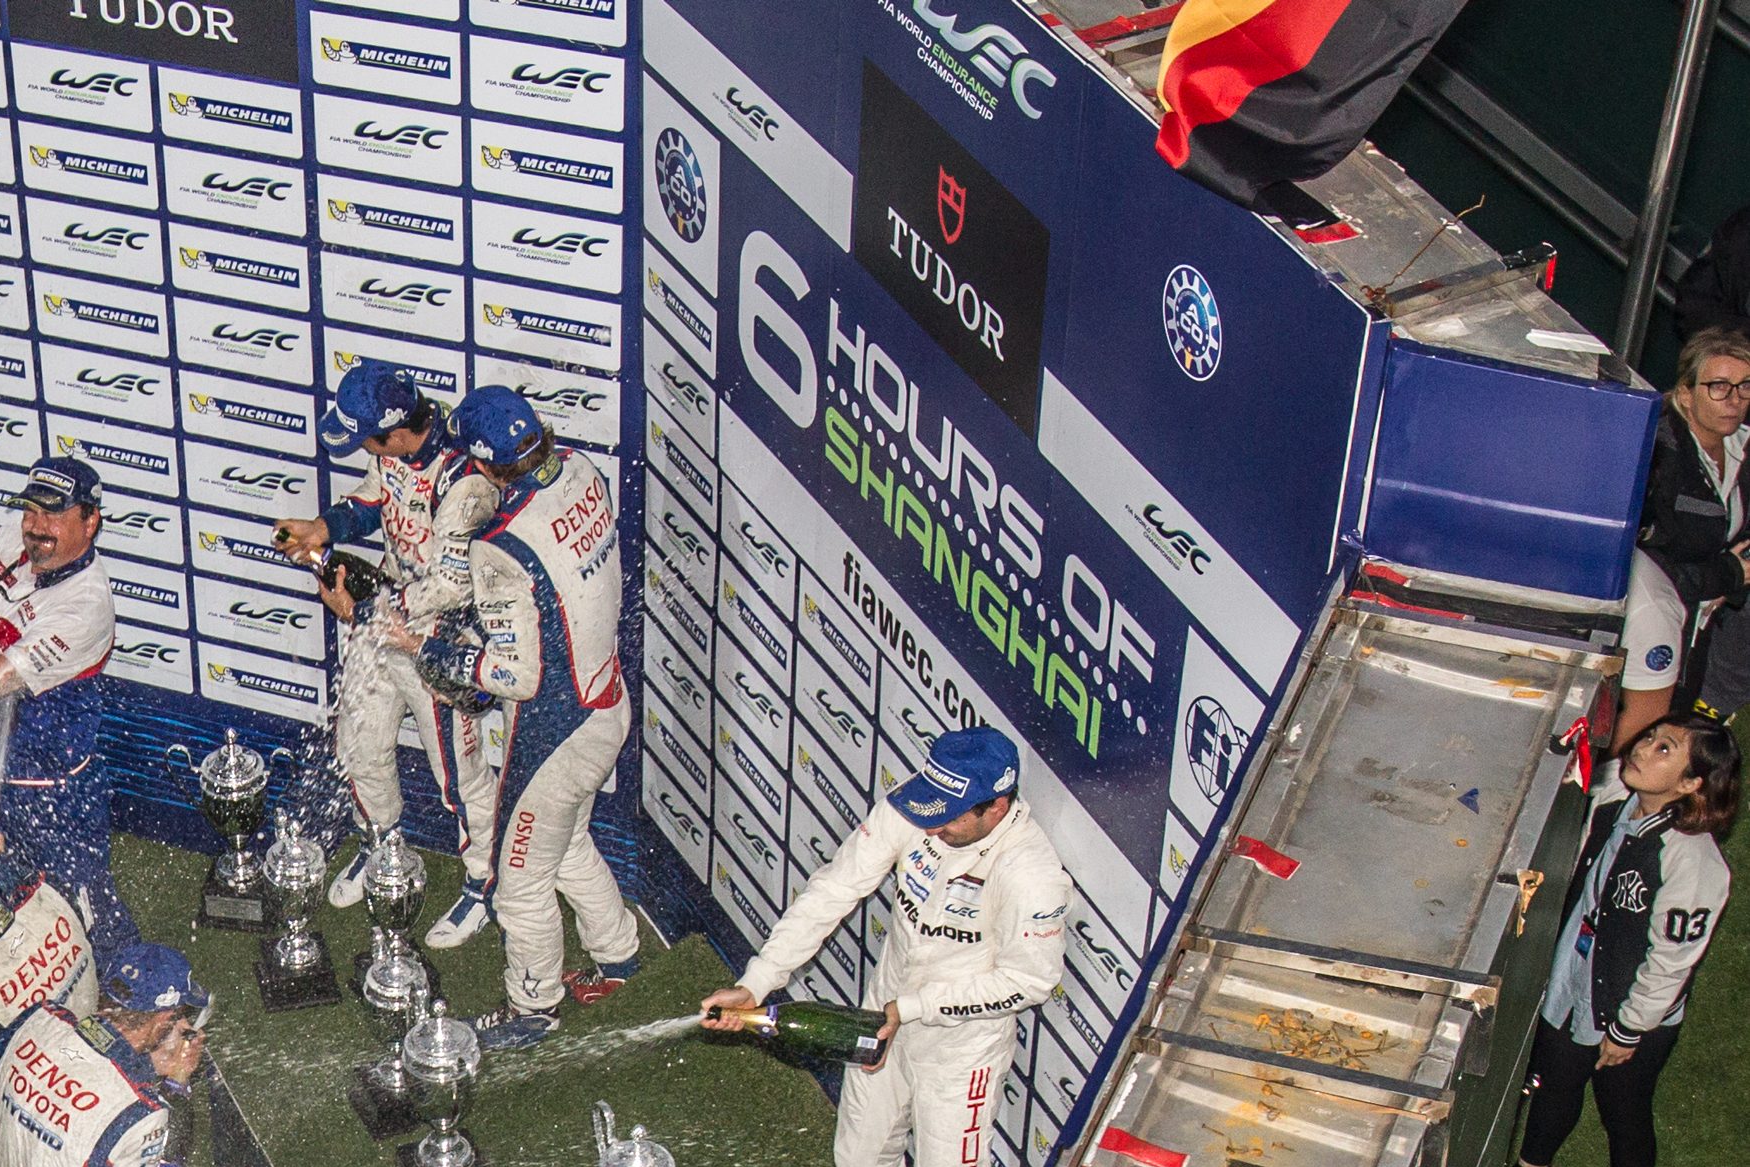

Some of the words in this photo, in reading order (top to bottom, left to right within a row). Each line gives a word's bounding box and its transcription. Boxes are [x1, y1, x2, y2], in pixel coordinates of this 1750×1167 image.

[360, 48, 448, 72] MICHELIN
[896, 9, 932, 48] WORLD
[932, 43, 999, 110] ENDURANCE
[913, 0, 1057, 120] WEC
[40, 85, 63, 94] WORLD
[50, 69, 138, 96] WEC
[498, 81, 524, 90] WORLD
[510, 63, 612, 92] WEC
[917, 47, 994, 121] CHAMPIONSHIP
[206, 103, 289, 126] MICHELIN
[726, 86, 779, 141] WEC
[342, 137, 367, 146] WORLD
[354, 120, 449, 149] WEC
[66, 156, 145, 179] MICHELIN
[520, 156, 610, 181] MICHELIN
[192, 188, 215, 197] WORLD
[202, 172, 292, 200] WEC
[64, 222, 149, 249] WEC
[365, 210, 451, 234] MICHELIN
[500, 244, 525, 252] WORLD
[511, 228, 610, 256] WEC
[215, 258, 296, 282] MICHELIN
[887, 206, 1005, 362] TUDOR
[348, 293, 372, 302] WORLD
[359, 278, 452, 306] WEC
[78, 305, 156, 328] MICHELIN
[521, 314, 609, 340] MICHELI
[666, 292, 710, 343] MICHELIN
[212, 323, 300, 350] WEC
[77, 368, 160, 395] WEC
[663, 361, 709, 415] WEC
[225, 404, 304, 428] MICHELIN
[91, 445, 166, 469] MICHELIN
[738, 230, 817, 428] 6
[827, 297, 1044, 579] HOURS
[1062, 553, 1155, 683] OF
[221, 466, 306, 493] WEC
[550, 476, 605, 544] DENSO
[1133, 513, 1151, 533] WORLD
[569, 506, 613, 560] TOYOTA
[1143, 503, 1211, 575] WEC
[740, 521, 789, 577] WEC
[825, 406, 1103, 760] SHANGHAI
[229, 602, 313, 628] WEC
[741, 606, 785, 662] MICHELIN
[822, 620, 870, 678] MICHELIN
[241, 674, 316, 699] MICHELIN
[661, 656, 705, 709] WEC
[735, 671, 783, 728] WEC
[815, 688, 867, 747] WEC
[665, 733, 705, 786] MICHELIN
[737, 752, 780, 807] MICHELIN
[926, 764, 965, 790] MICHELIN
[660, 792, 703, 846] WEC
[509, 811, 535, 868] DENSO
[732, 813, 778, 869] WEC
[945, 903, 980, 919] WEC
[920, 922, 982, 944] MORI
[1665, 908, 1710, 943] 03
[1074, 919, 1133, 990] WEC
[18, 944, 83, 1011] TOYOTA
[939, 1005, 983, 1016] DMG
[985, 992, 1025, 1012] MOR
[15, 1038, 100, 1111] DENSO
[8, 1065, 71, 1133] TOYOTA
